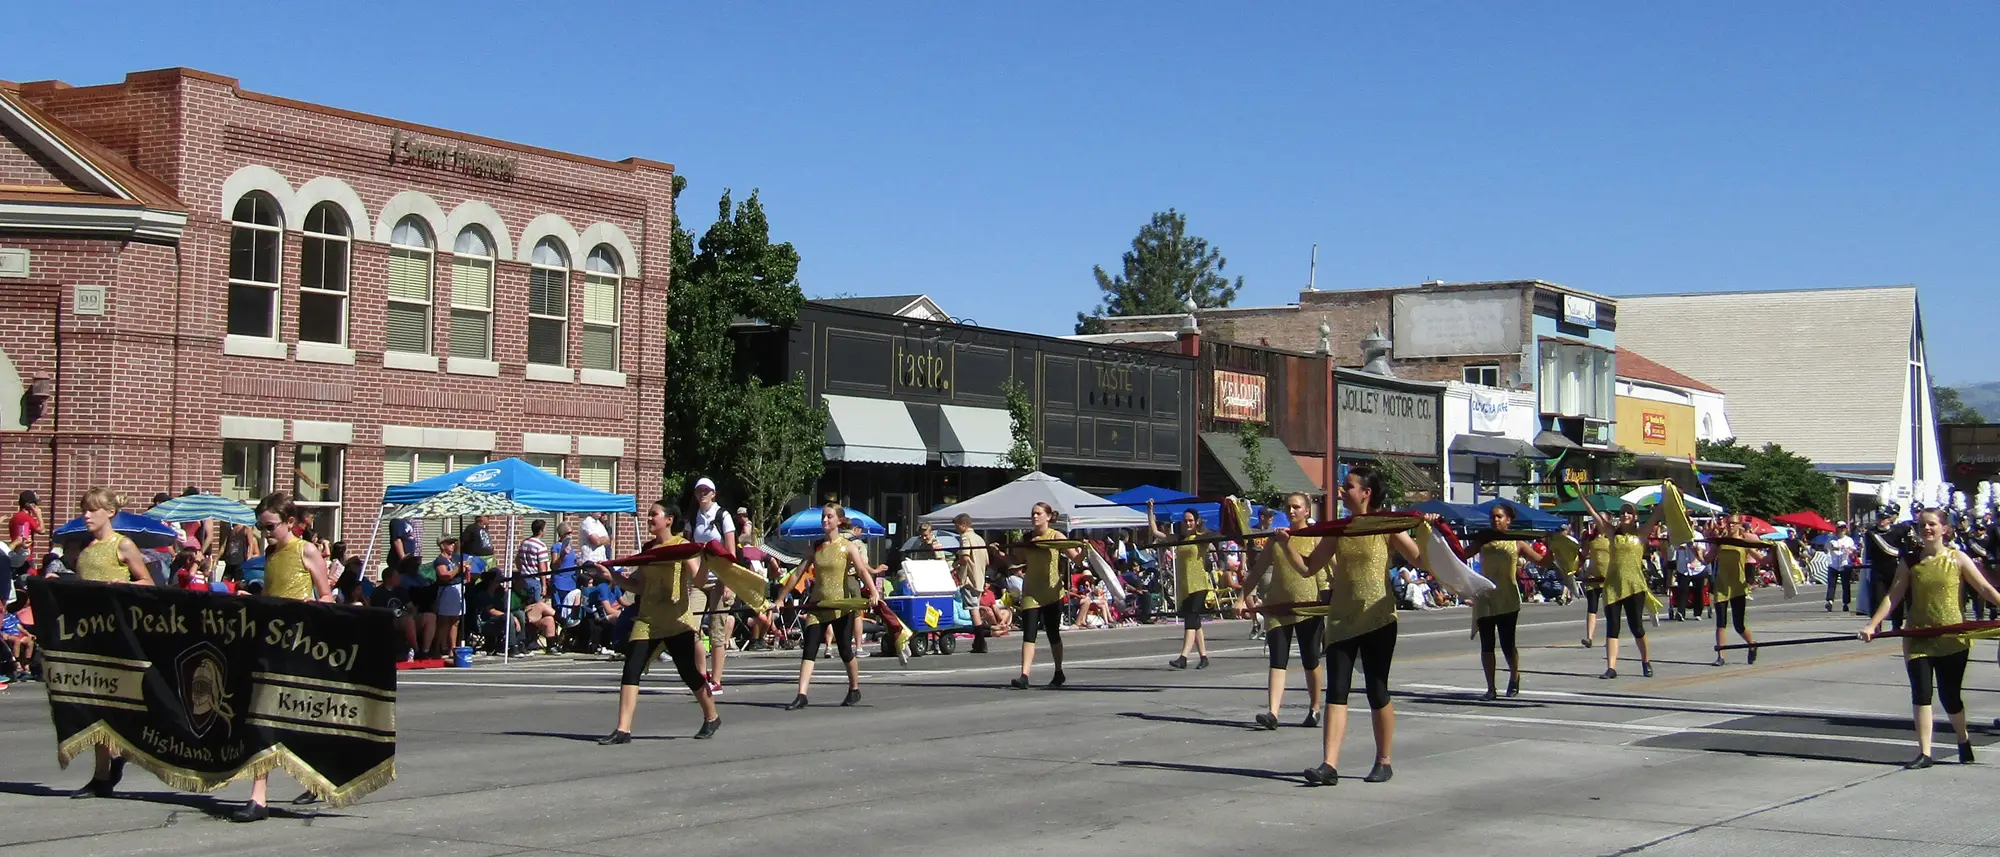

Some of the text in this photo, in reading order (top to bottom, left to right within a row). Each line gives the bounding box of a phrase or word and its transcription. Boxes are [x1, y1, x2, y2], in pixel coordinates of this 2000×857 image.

[405, 137, 519, 181] Smart Financial
[80, 294, 98, 308] 99
[898, 346, 949, 390] taste.
[1095, 365, 1133, 392] TASTE
[1220, 380, 1261, 402] VELOUR
[1342, 386, 1432, 419] JOLLEY MOTOR CO.
[56, 604, 359, 671] Lone Peak High School
[278, 692, 358, 719] Knights
